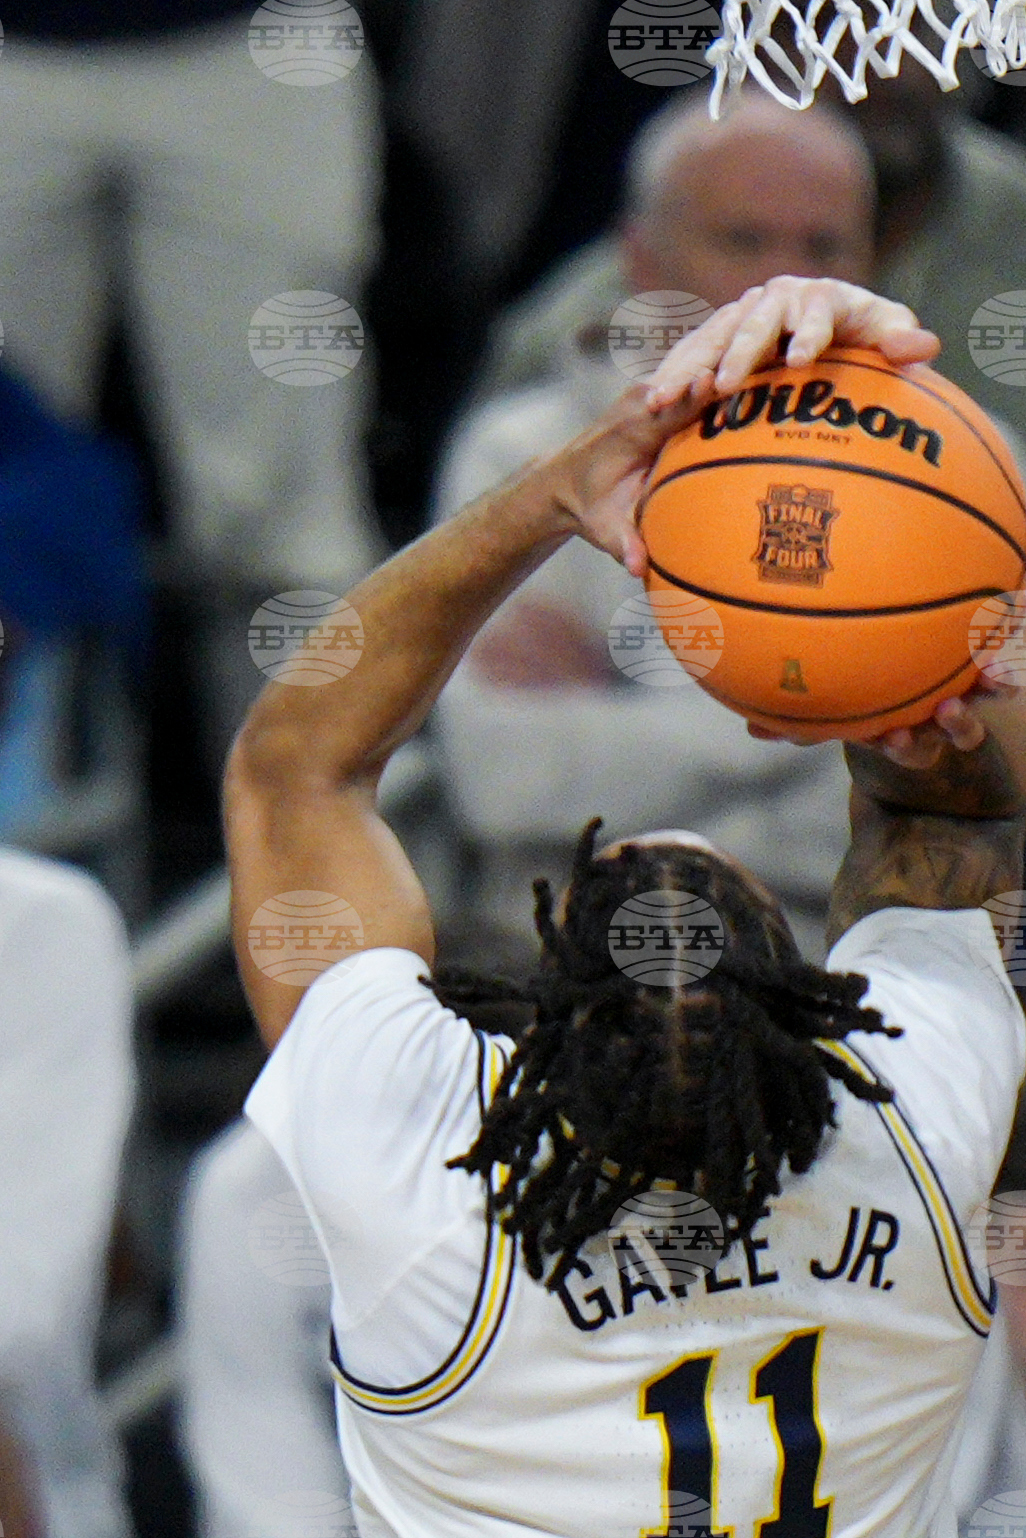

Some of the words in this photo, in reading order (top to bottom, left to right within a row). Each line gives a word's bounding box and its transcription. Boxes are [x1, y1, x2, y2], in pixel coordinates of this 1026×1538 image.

[766, 502, 823, 530] FINAL
[763, 546, 820, 569] FOUR
[809, 1206, 900, 1292] JR.
